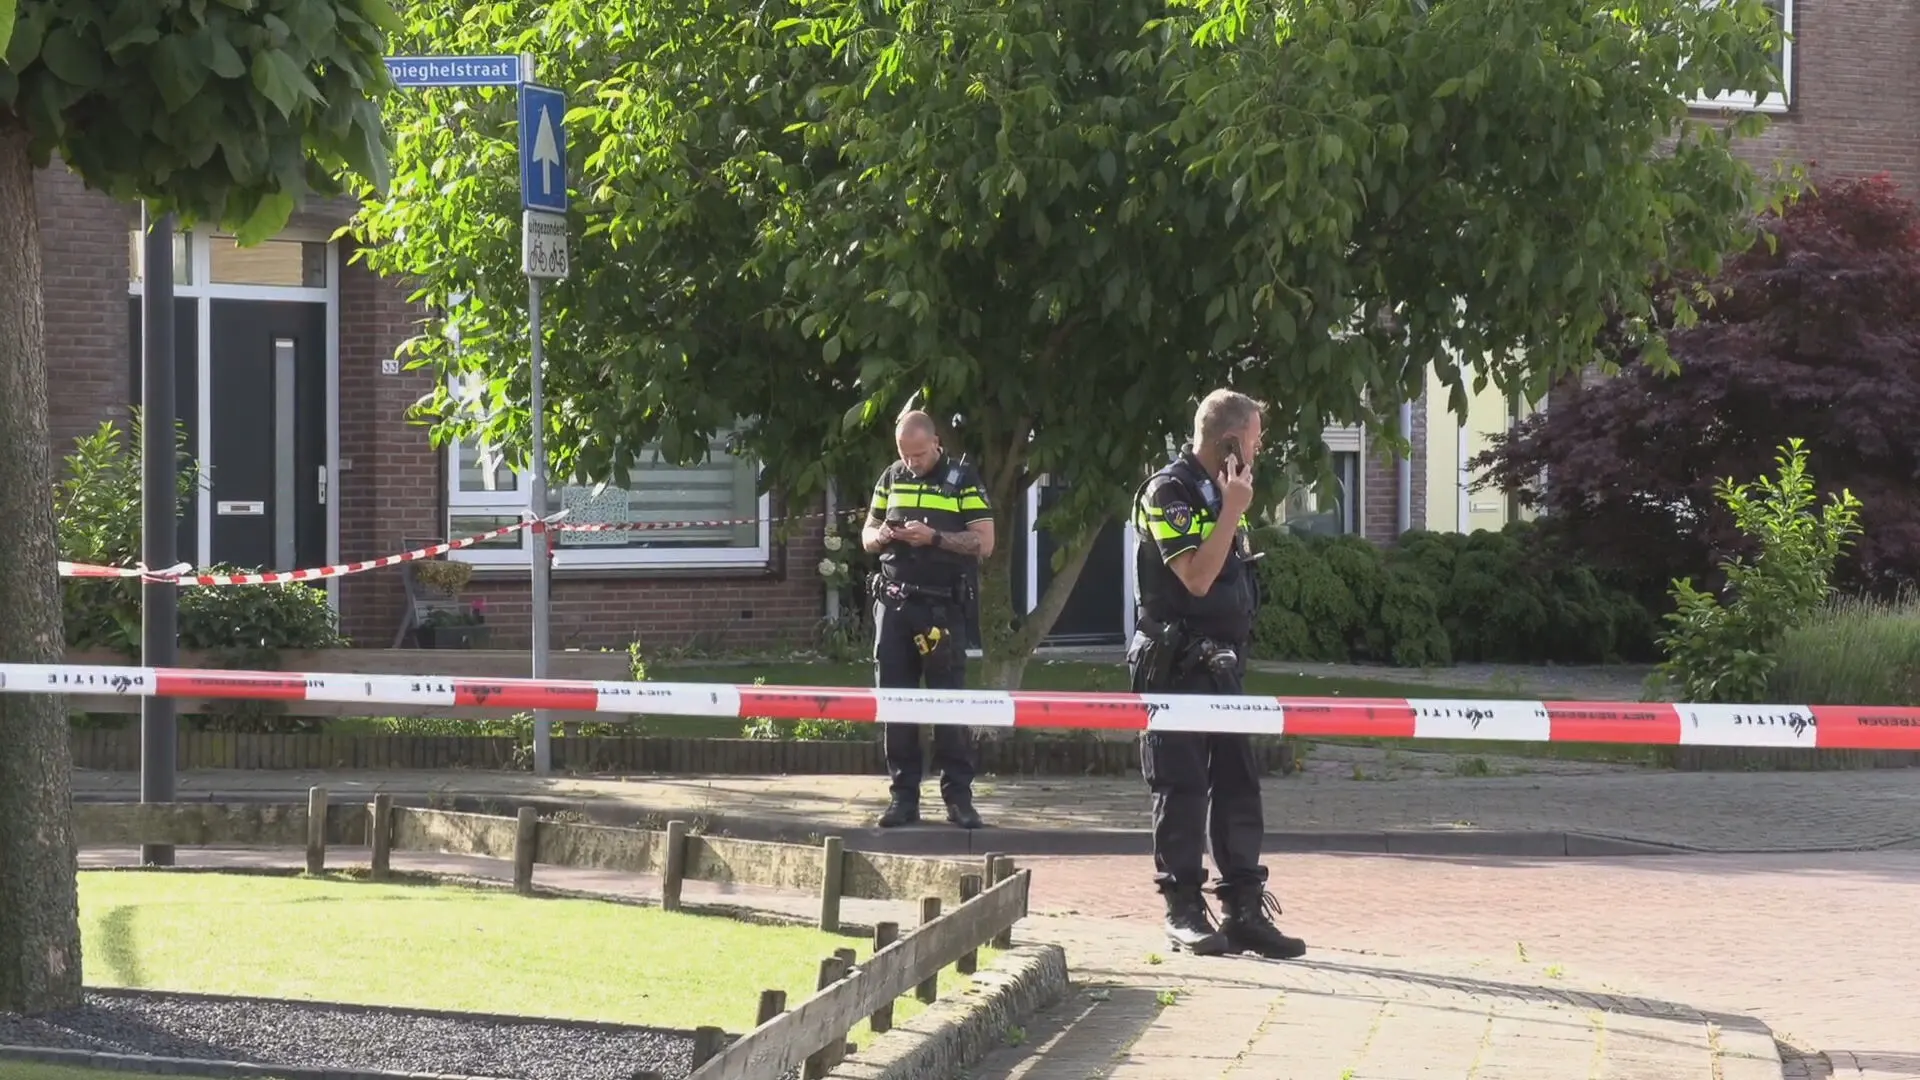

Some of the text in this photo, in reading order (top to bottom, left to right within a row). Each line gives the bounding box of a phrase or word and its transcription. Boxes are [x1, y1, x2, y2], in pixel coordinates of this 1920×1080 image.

[529, 220, 566, 239] uitgezonderd
[1732, 713, 1817, 734] POLITIE
[1857, 717, 1920, 727] TREDEN
